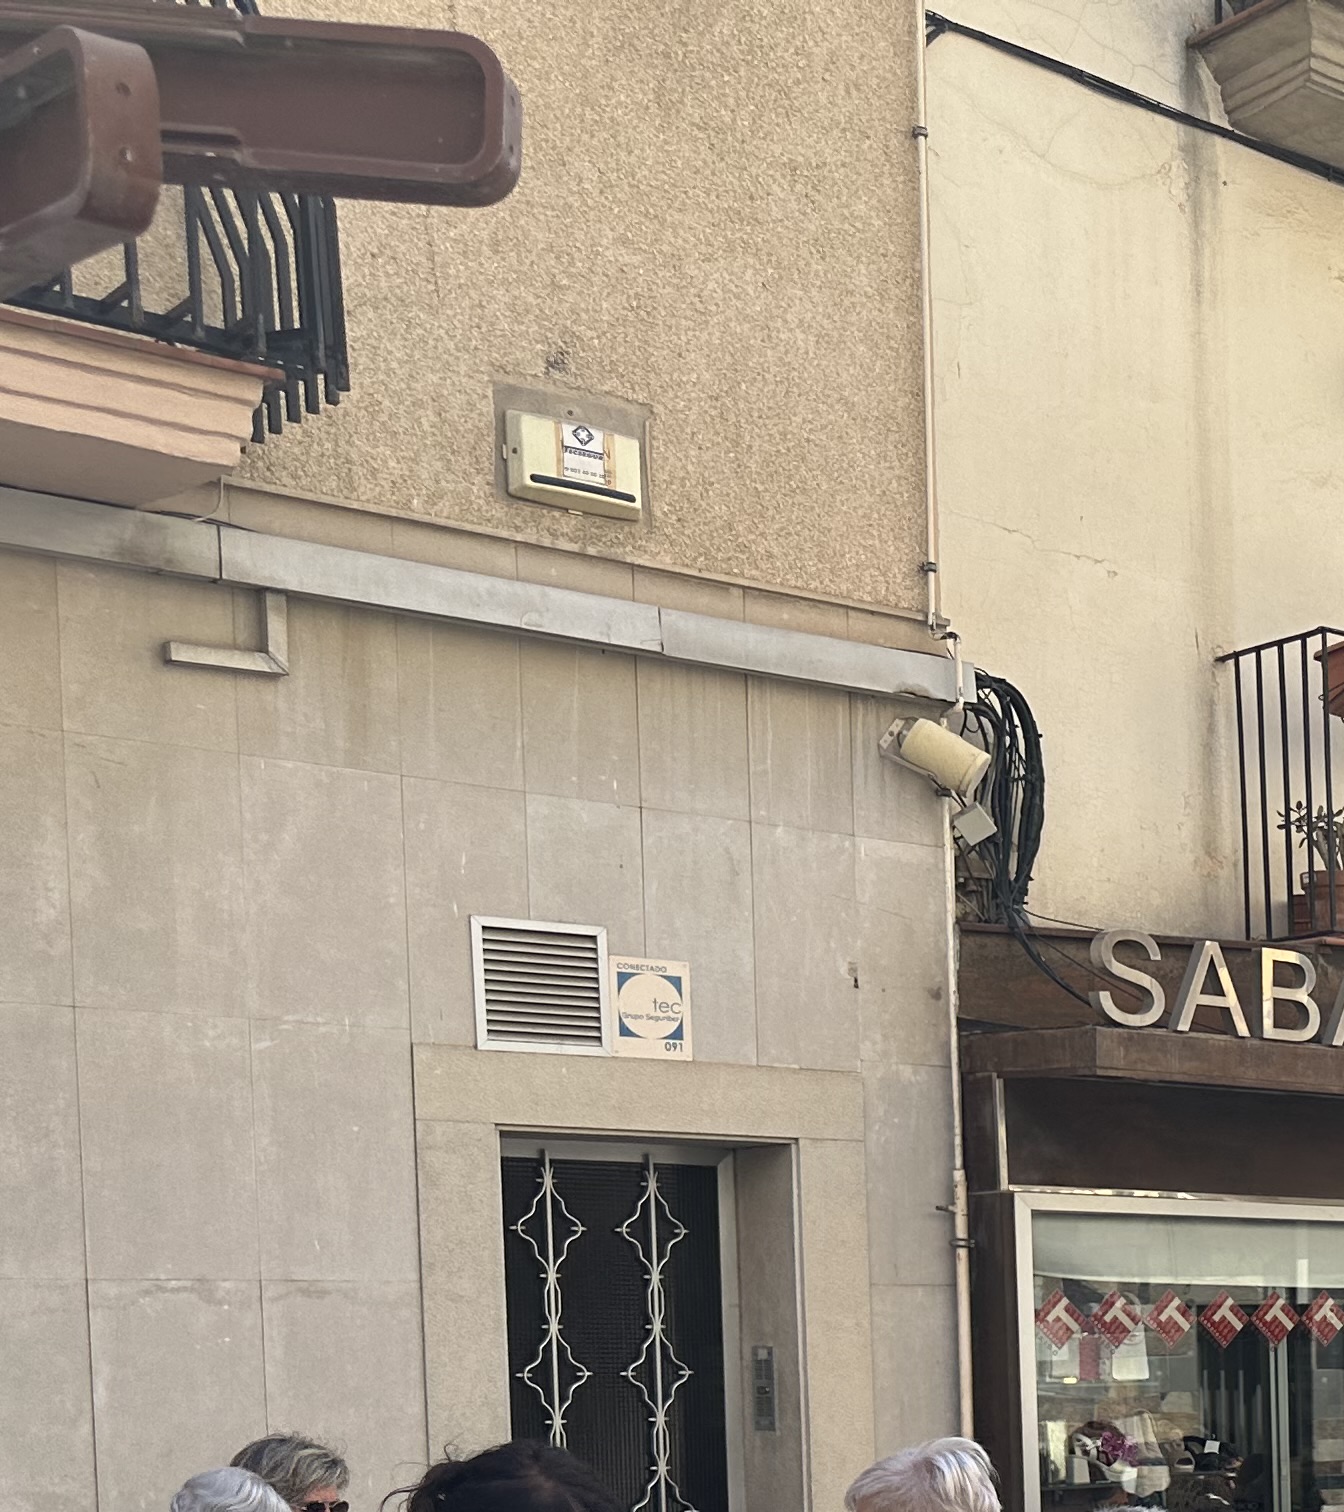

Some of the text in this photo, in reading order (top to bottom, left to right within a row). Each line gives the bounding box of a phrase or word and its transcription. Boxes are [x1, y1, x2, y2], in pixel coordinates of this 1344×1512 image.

[616, 962, 668, 973] CONECTADO
[652, 997, 682, 1014] tec
[664, 1041, 683, 1053] 091
